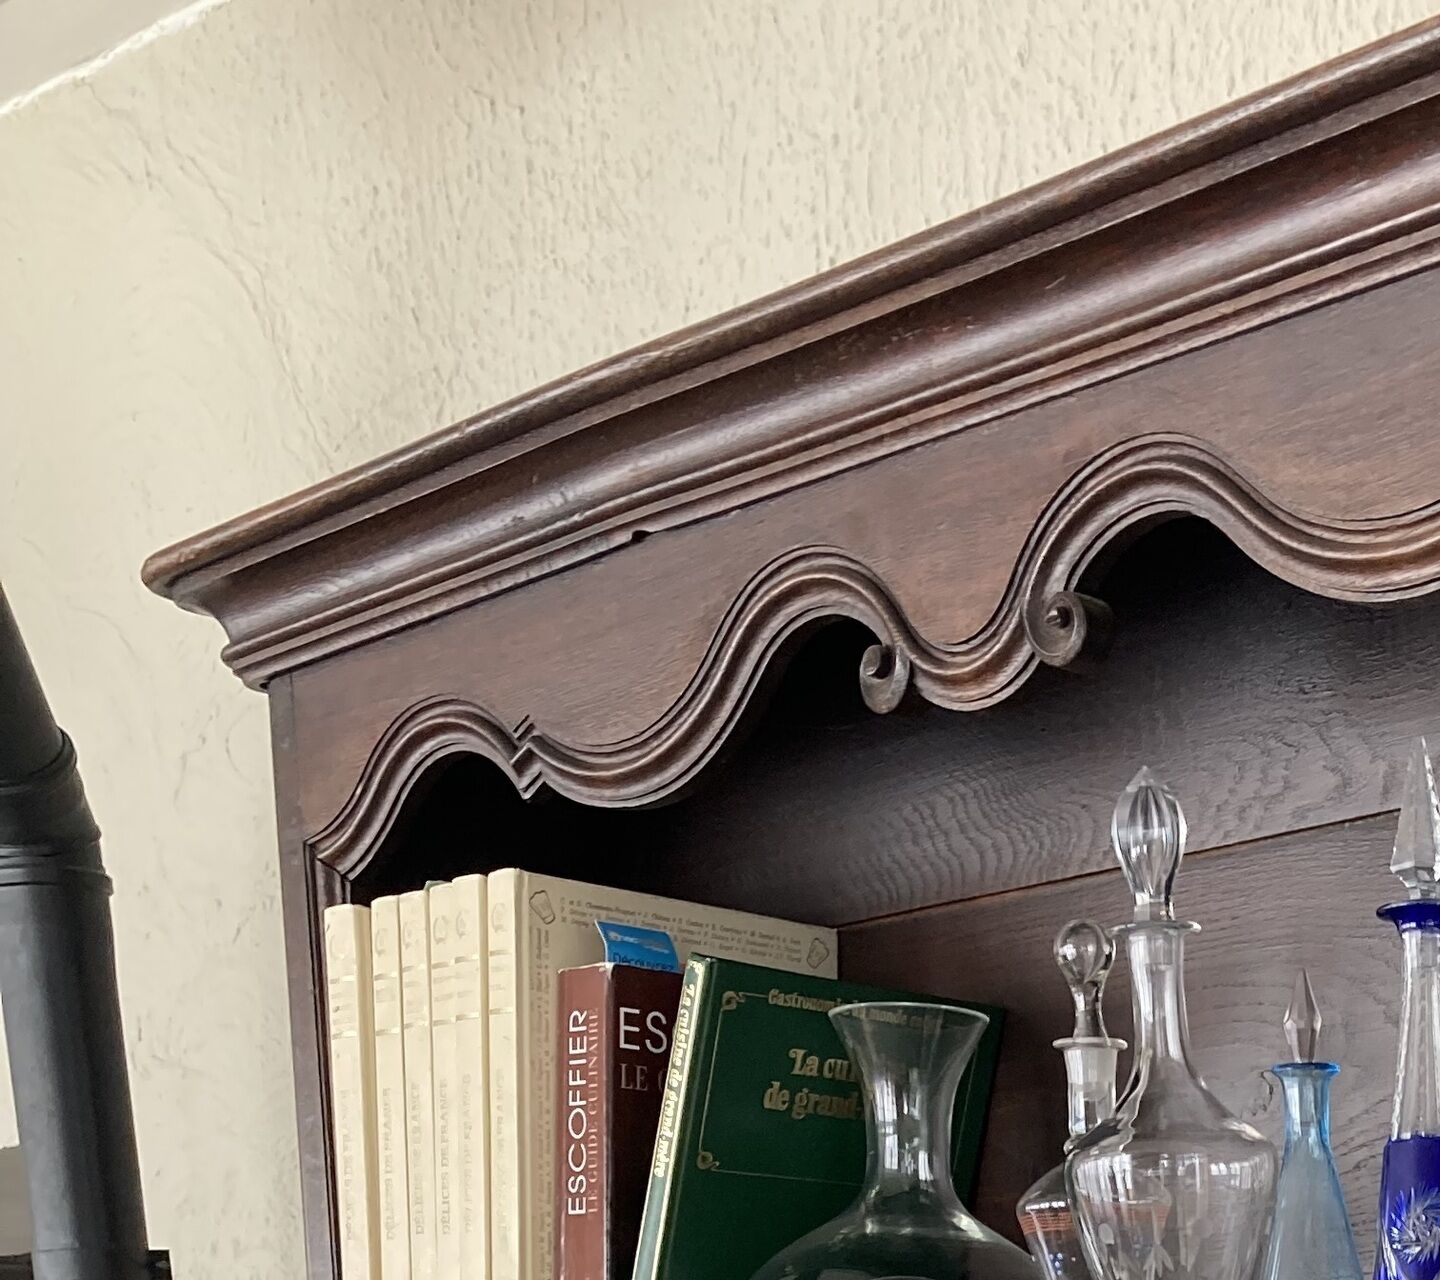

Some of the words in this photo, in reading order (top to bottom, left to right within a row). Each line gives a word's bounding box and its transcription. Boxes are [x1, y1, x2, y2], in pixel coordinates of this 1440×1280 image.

[618, 1006, 668, 1054] ES
[588, 1007, 599, 1115] CULINAIRE
[620, 1063, 648, 1091] LE
[788, 1048, 819, 1078] La
[567, 1009, 588, 1216] ESCOFFIER
[763, 1081, 789, 1111] de
[588, 1123, 598, 1184] GUIDE
